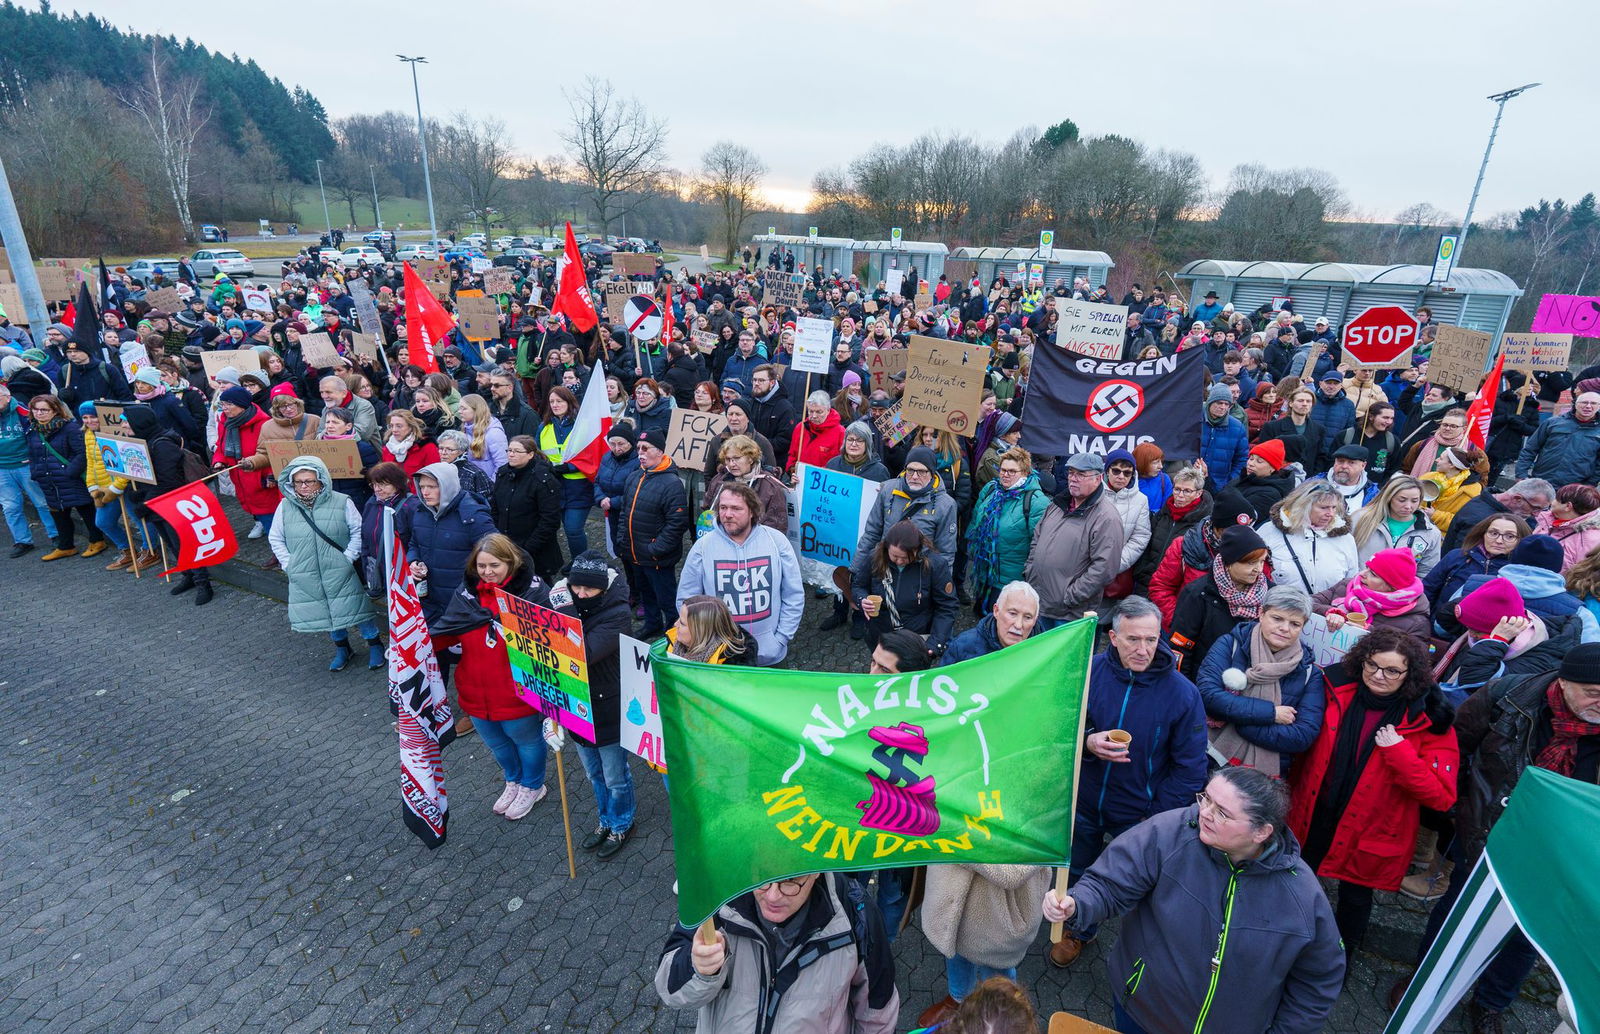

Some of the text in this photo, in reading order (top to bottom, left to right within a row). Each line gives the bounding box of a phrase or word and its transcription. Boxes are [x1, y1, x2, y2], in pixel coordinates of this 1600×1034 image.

[767, 271, 791, 282] NICHT
[1065, 306, 1125, 324] SIE SPIELEN
[1070, 324, 1121, 337] MIT EUREN
[1348, 325, 1413, 346] STOP
[1505, 336, 1568, 347] Nazis kommen
[927, 349, 949, 366] Für
[1075, 353, 1178, 376] GEGEN
[1529, 356, 1565, 366] Macht!
[909, 366, 967, 389] Demokratie
[1436, 369, 1464, 390] 1933
[923, 386, 945, 398] und
[908, 395, 948, 414] Freiheit
[681, 414, 719, 436] FCK
[880, 421, 893, 435] DIE
[327, 443, 338, 453] im
[809, 471, 850, 498] Blau
[816, 504, 833, 516] das
[819, 495, 830, 505] ist
[810, 513, 836, 525] neue
[800, 521, 851, 562] Braun
[716, 565, 770, 592] FCK
[722, 589, 771, 616] AFD
[506, 593, 566, 637] LEBE SO,
[517, 617, 551, 647] DASS
[515, 632, 534, 657] DIE
[536, 641, 560, 669] AFD
[531, 658, 561, 688] WAS
[521, 669, 572, 713] DAGEGEN
[540, 697, 561, 724] HAT
[801, 674, 990, 757] NAZIS?
[761, 785, 1005, 861] NEIN DANKE
